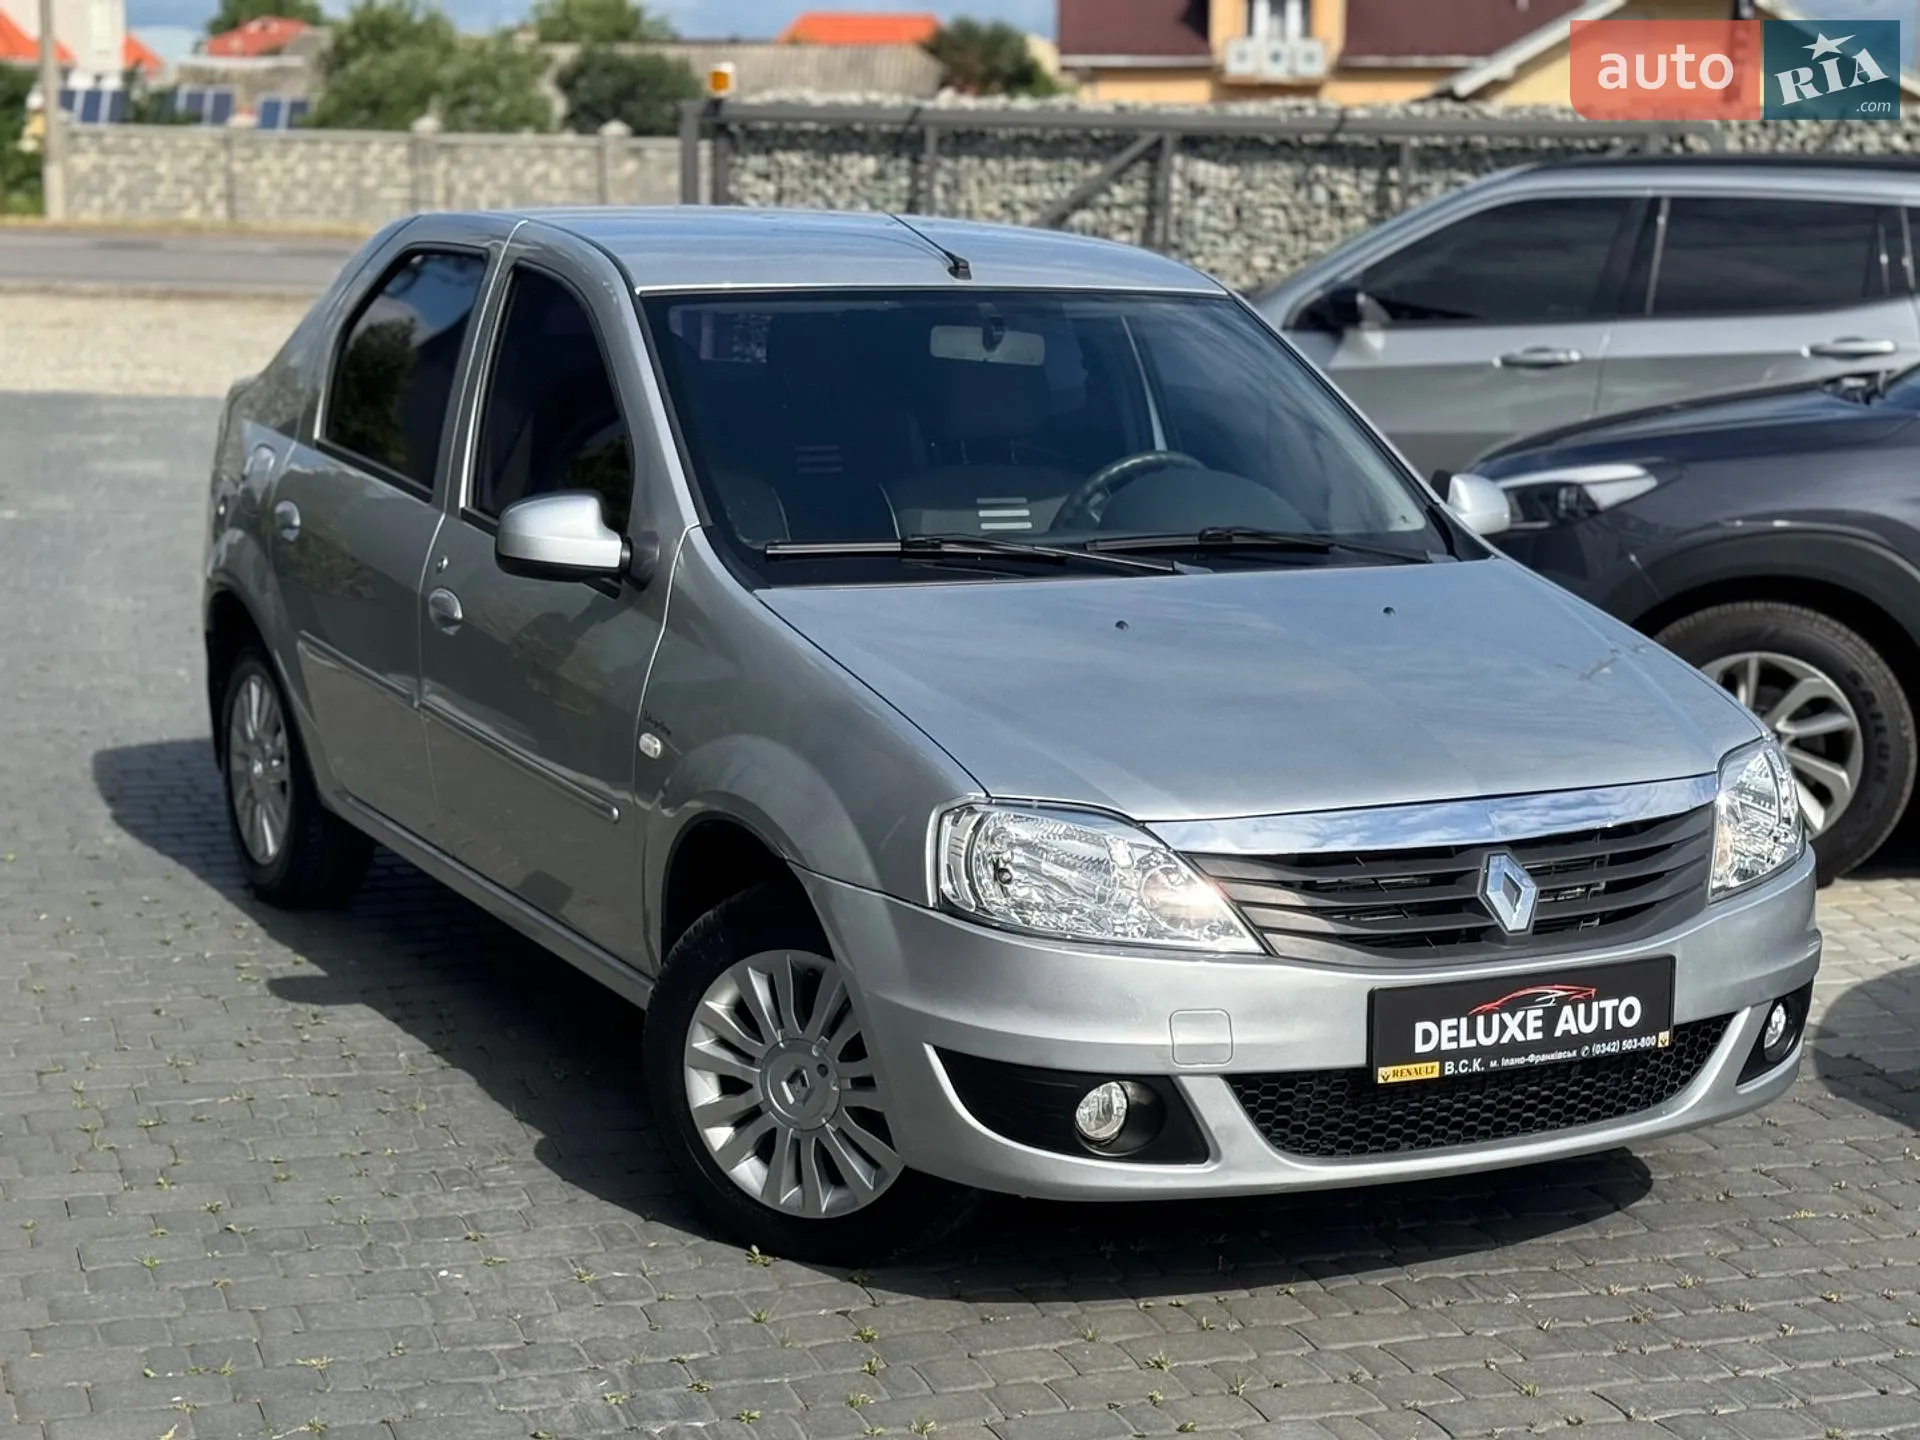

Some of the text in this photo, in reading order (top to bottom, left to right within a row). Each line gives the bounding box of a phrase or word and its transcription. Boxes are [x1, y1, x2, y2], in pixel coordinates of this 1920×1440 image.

[1414, 996, 1642, 1053] DELUXE AUTO
[1391, 1064, 1437, 1079] RENAULT
